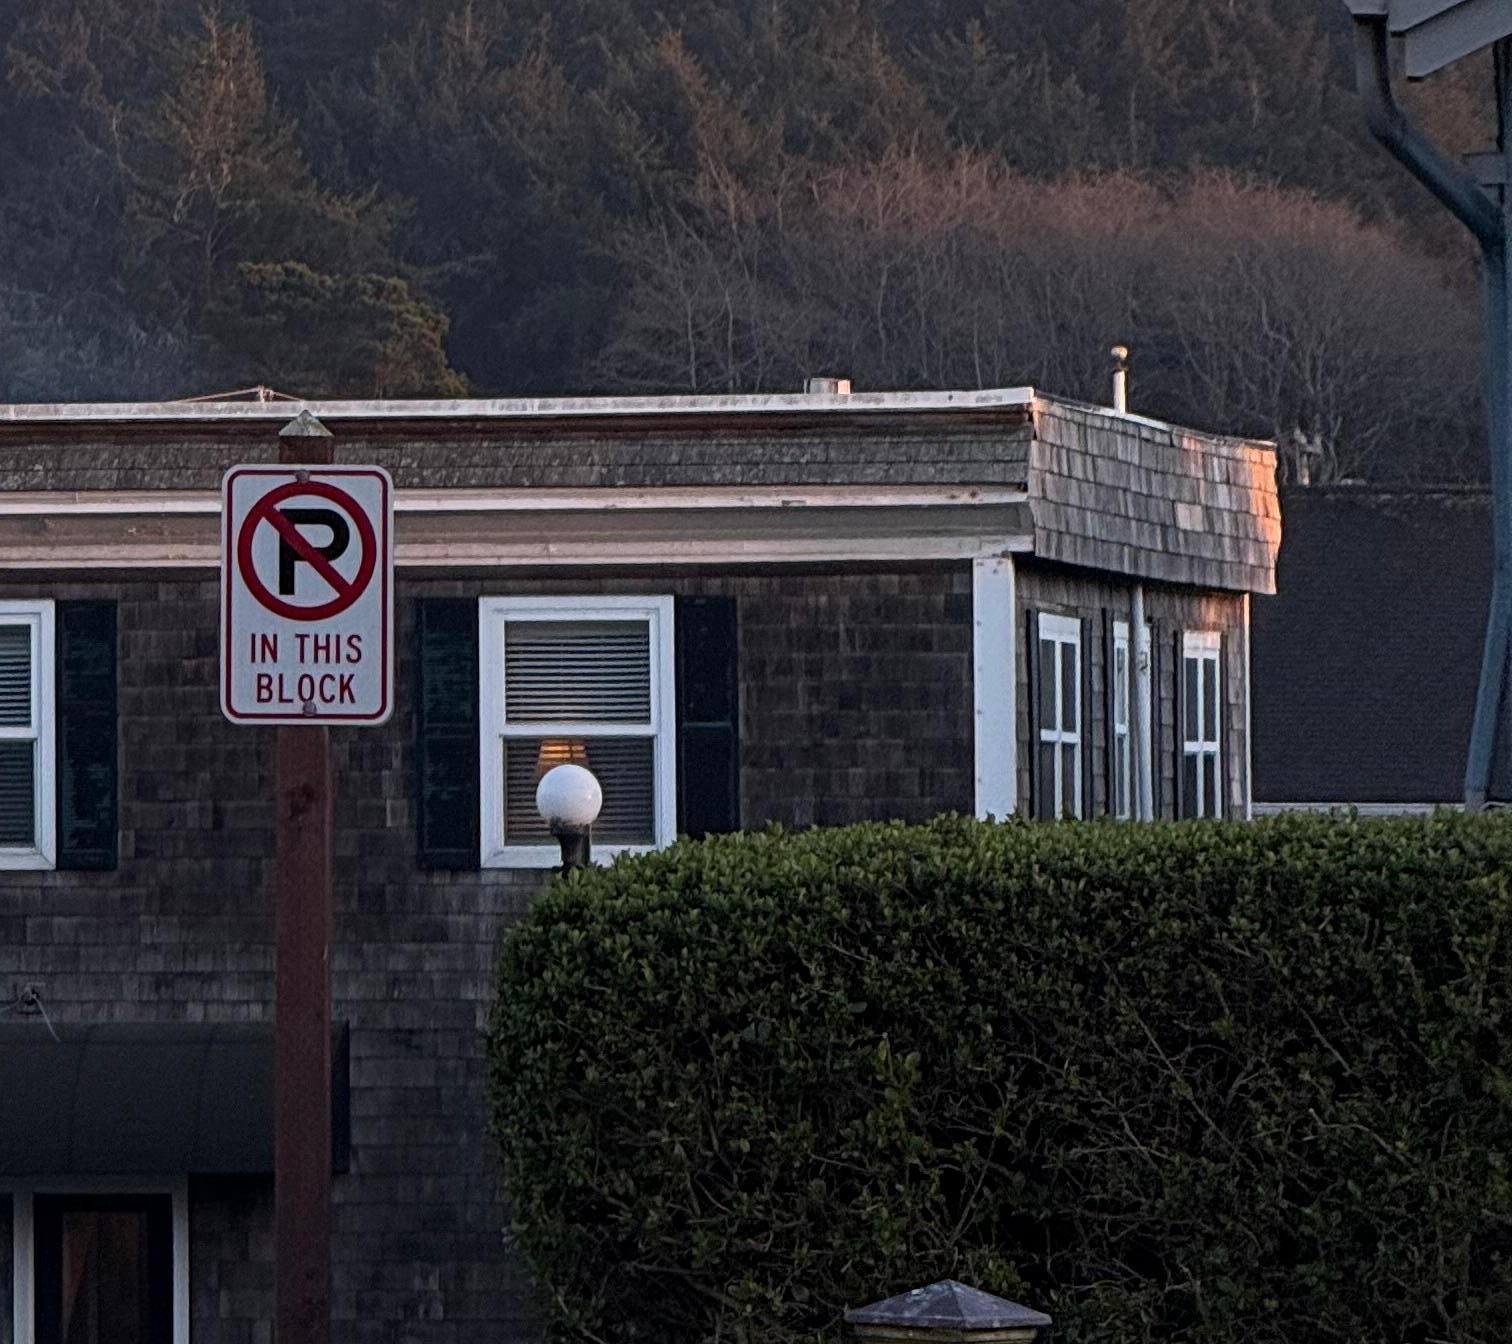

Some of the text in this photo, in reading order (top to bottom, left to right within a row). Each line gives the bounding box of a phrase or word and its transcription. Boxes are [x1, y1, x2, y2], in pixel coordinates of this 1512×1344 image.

[250, 634, 362, 663] IN THIS
[257, 673, 356, 703] BLOCK
